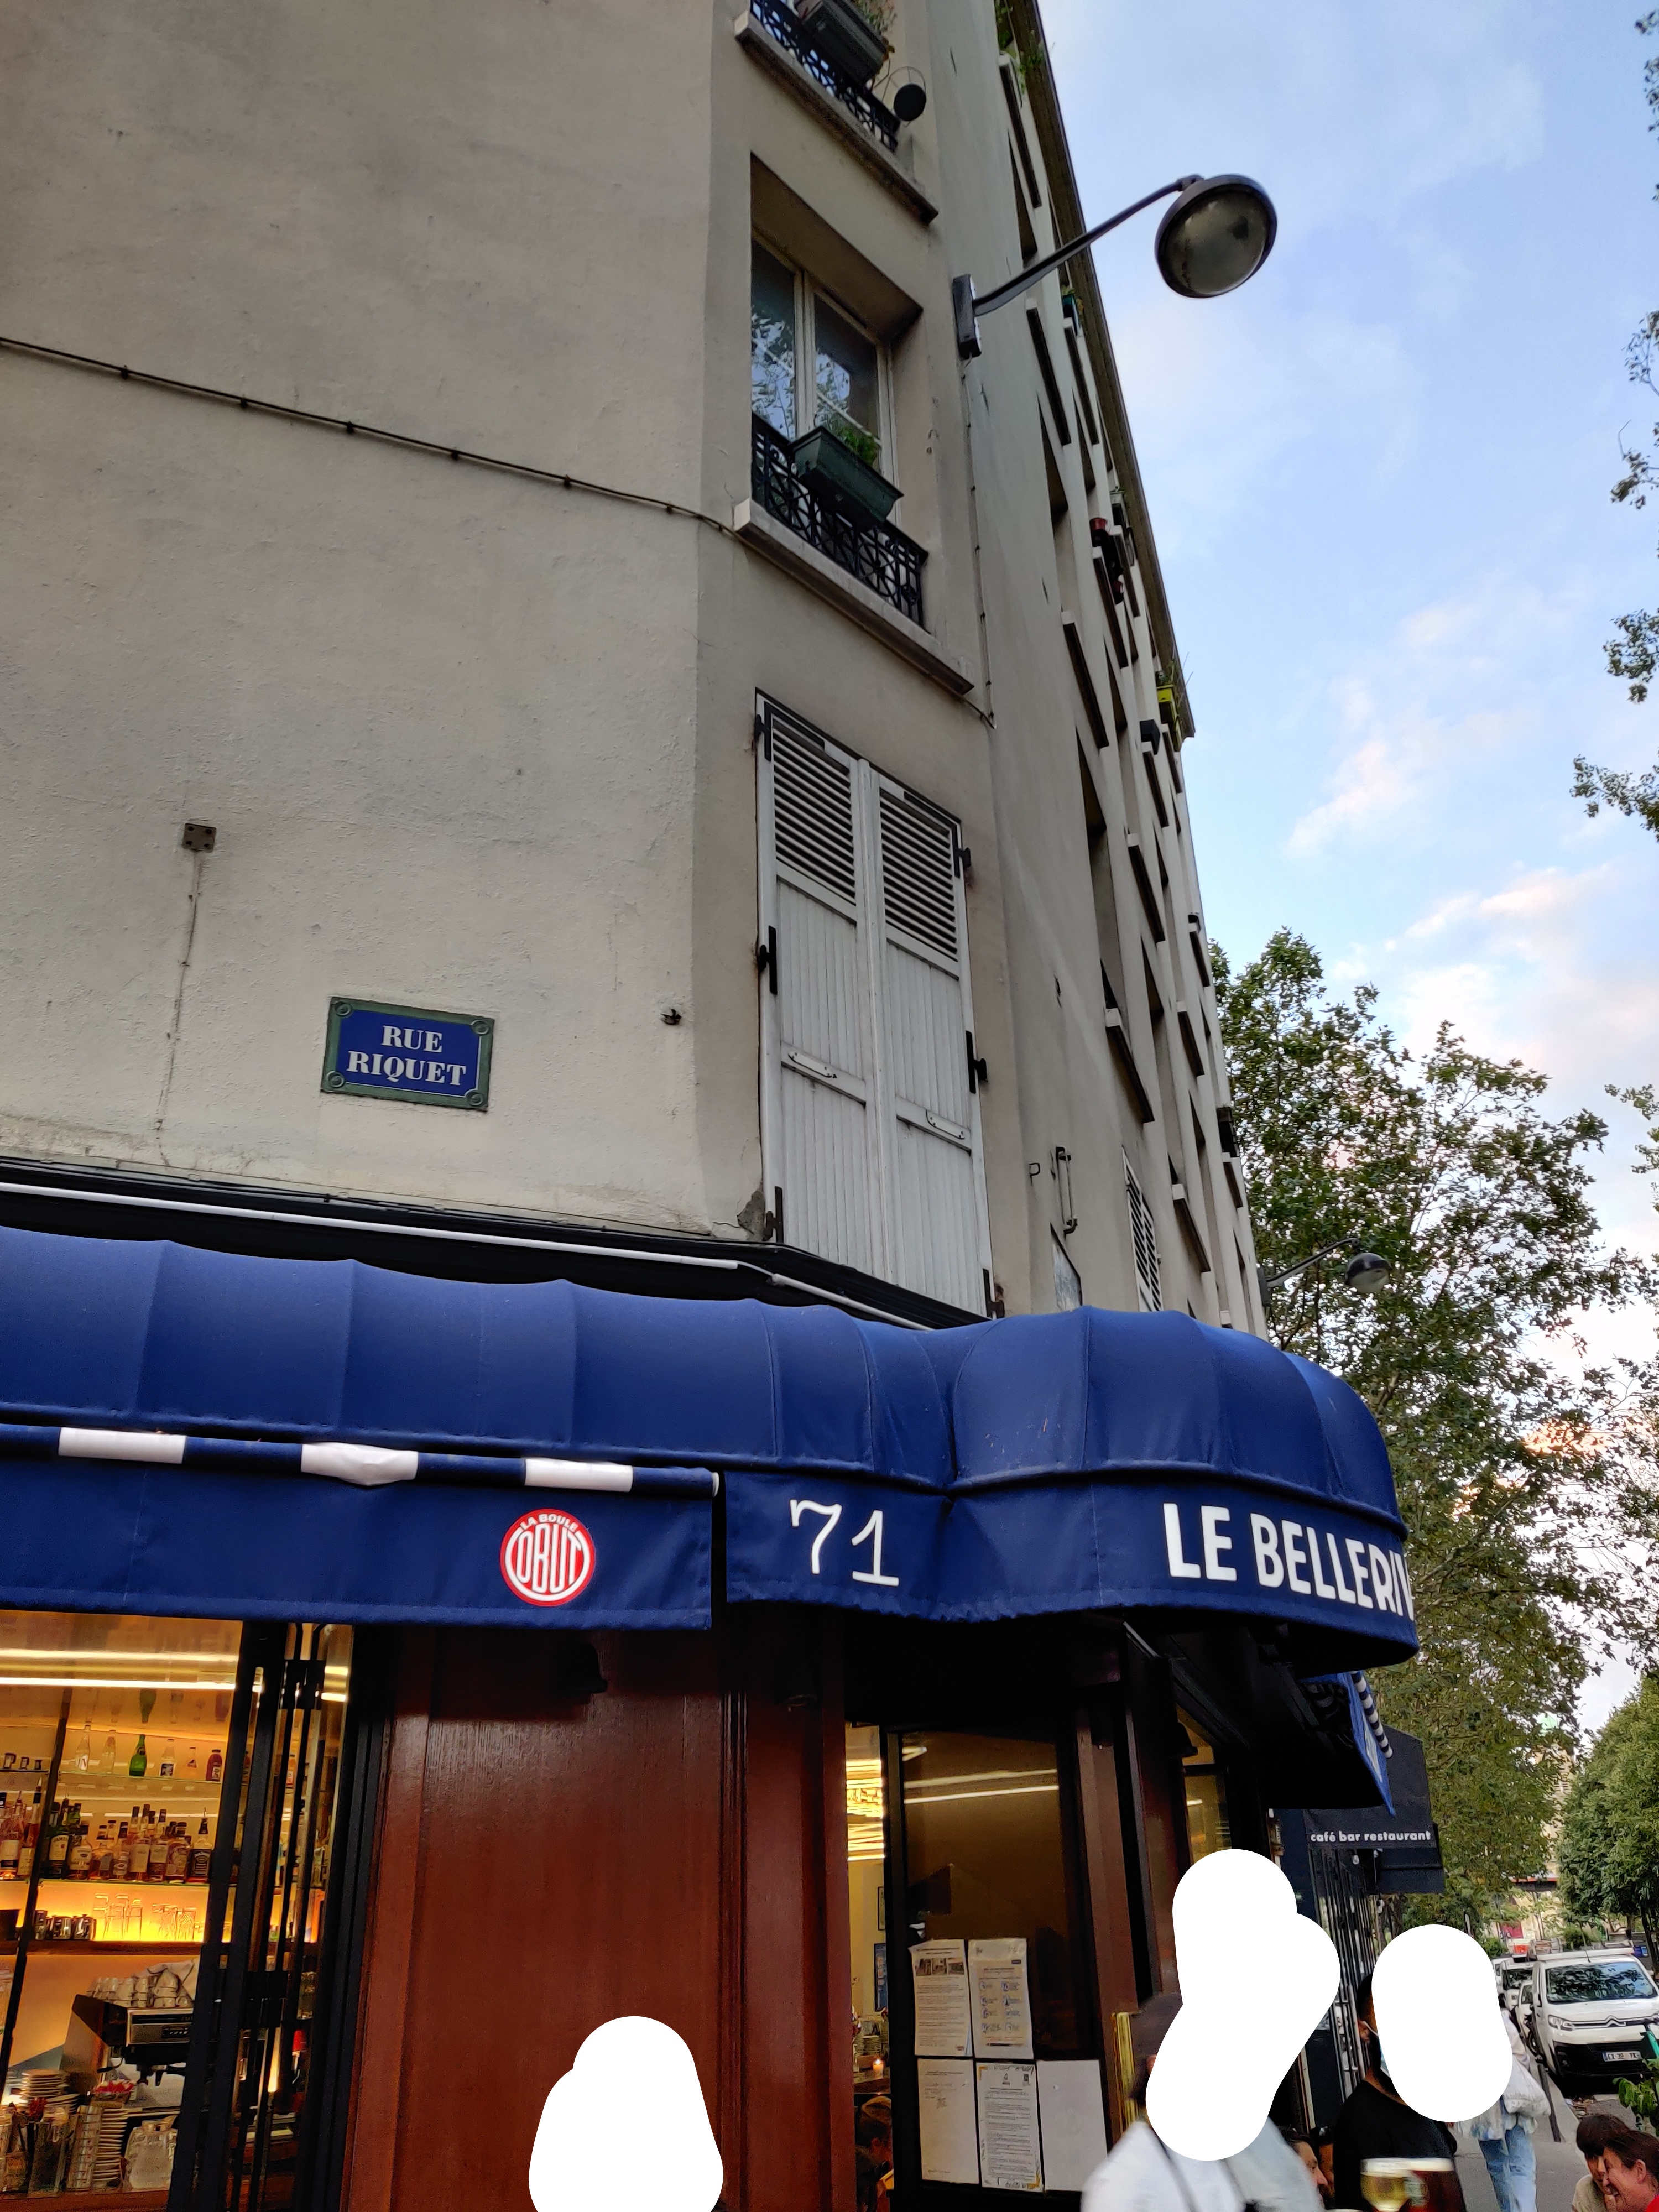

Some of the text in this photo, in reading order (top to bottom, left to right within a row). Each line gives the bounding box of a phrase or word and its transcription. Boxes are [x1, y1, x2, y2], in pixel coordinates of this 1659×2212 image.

[380, 1025, 442, 1053] RUE
[346, 1051, 466, 1086] RIQUET
[520, 1514, 578, 1533] LA BOULE
[515, 1522, 582, 1594] OBUT
[790, 1499, 899, 1586] 71
[1164, 1503, 1237, 1581] LE
[1310, 1830, 1431, 1842] café bar restaurant
